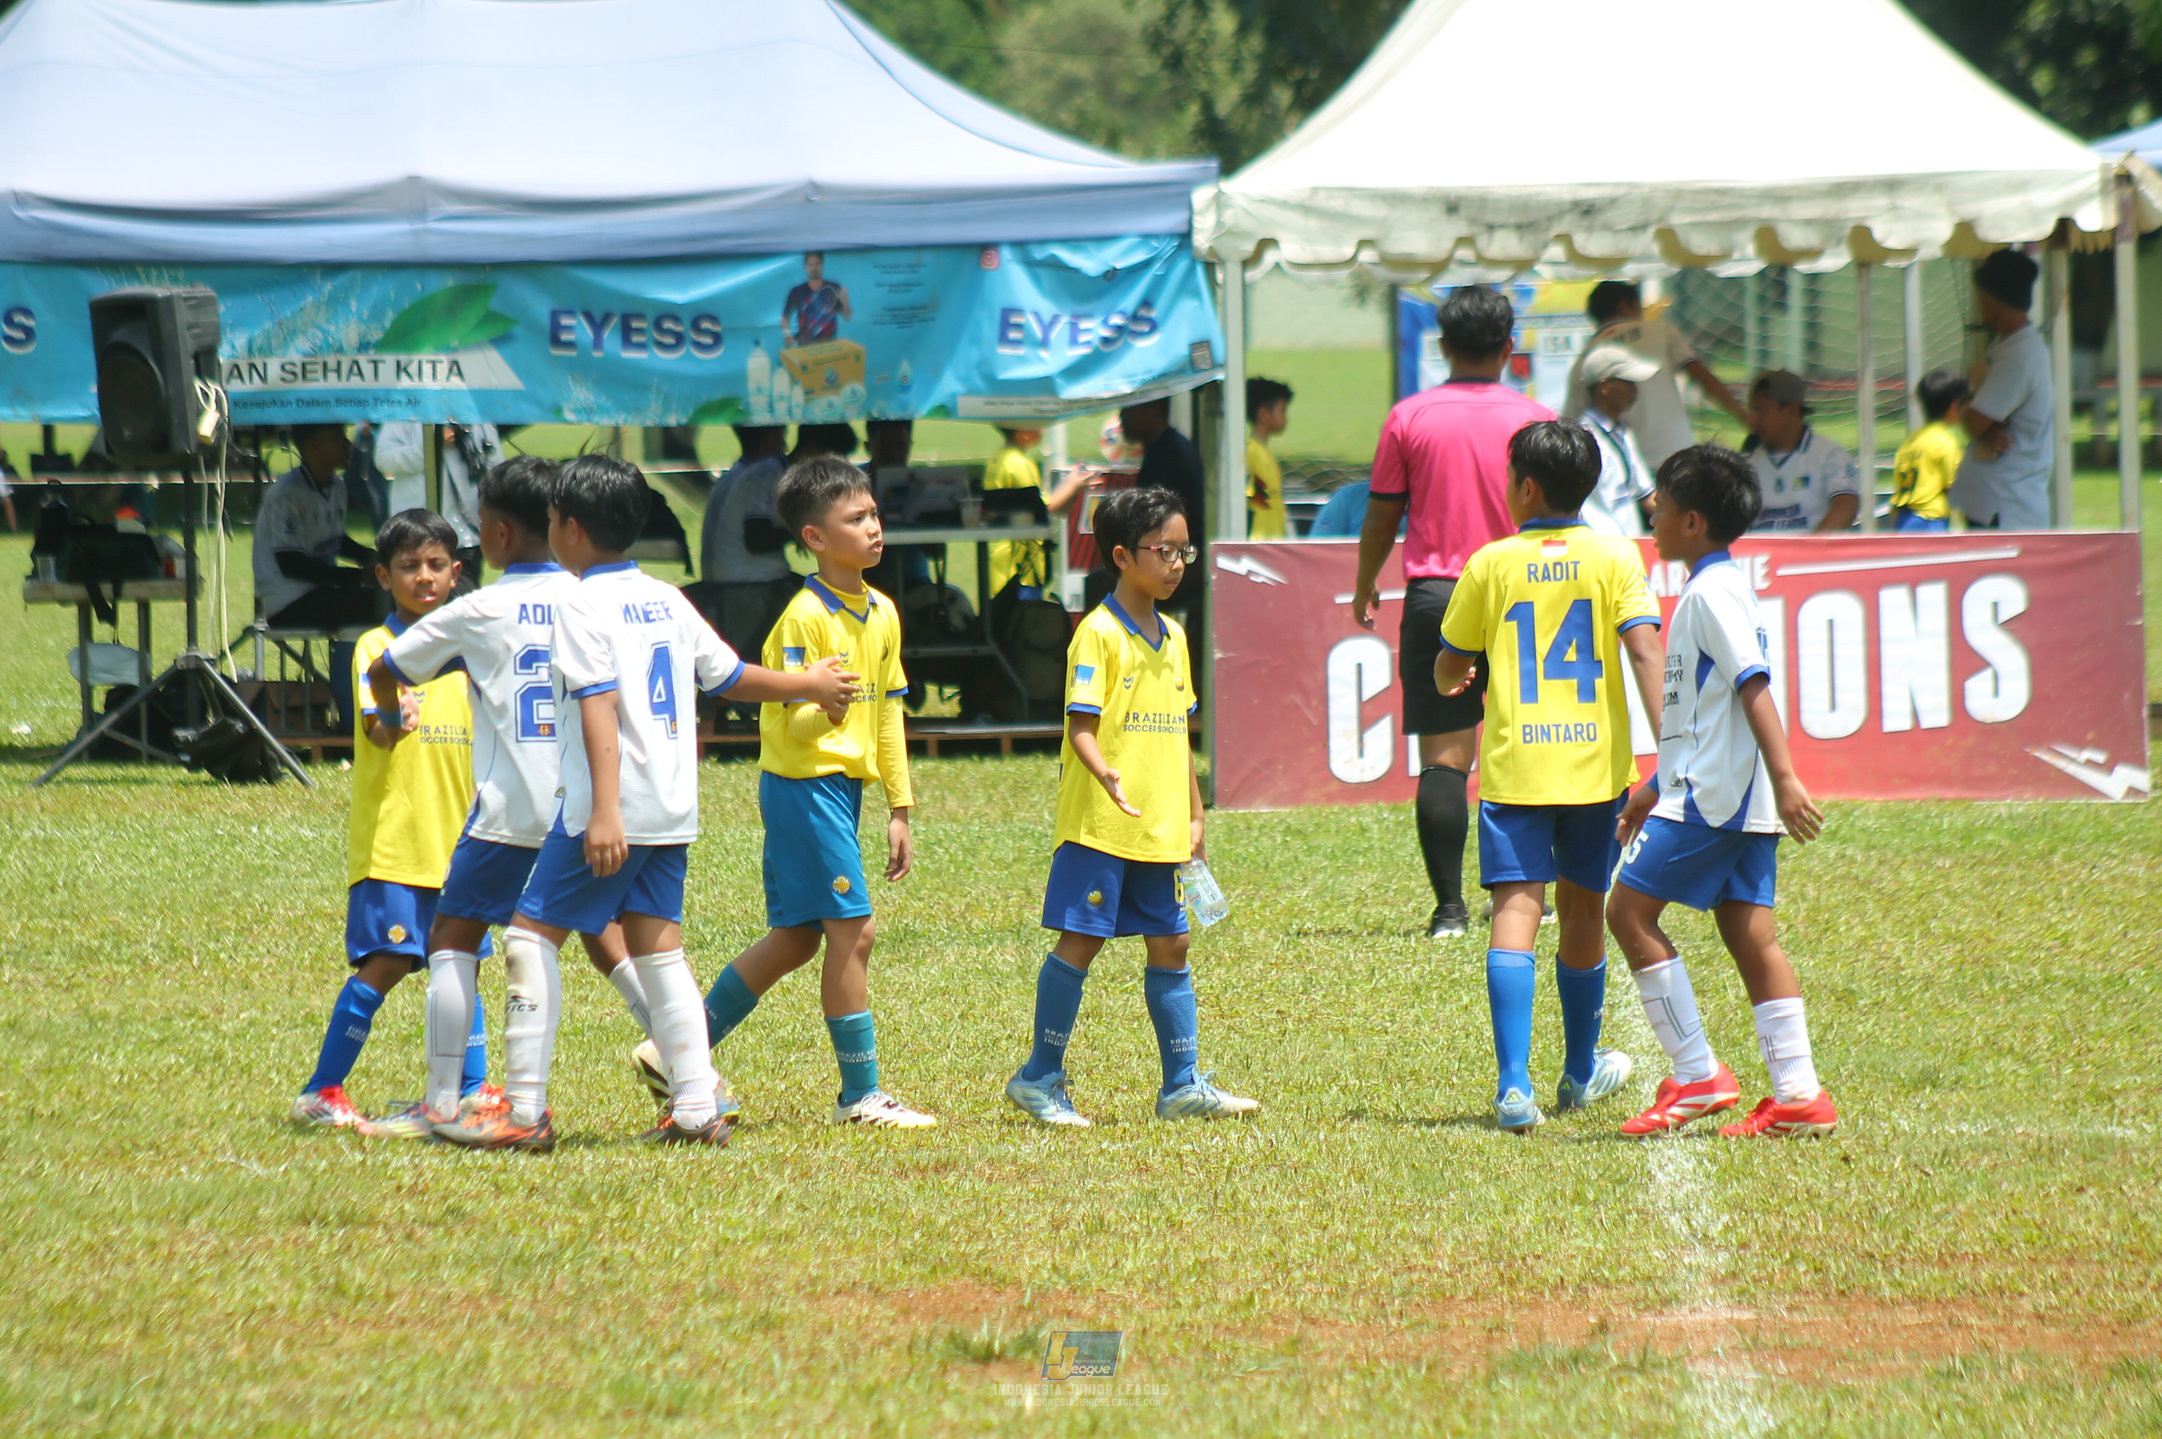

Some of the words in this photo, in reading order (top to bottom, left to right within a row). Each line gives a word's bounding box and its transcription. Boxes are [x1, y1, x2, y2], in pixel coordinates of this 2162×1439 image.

[549, 310, 726, 360] EYESS
[996, 301, 1161, 357] EYESS
[279, 358, 386, 384] SEHAT
[396, 358, 466, 383] KITA
[296, 397, 332, 409] Dalam
[1527, 560, 1581, 583] RADIT
[1504, 598, 1603, 704] 14
[646, 640, 678, 740] 4
[1123, 723, 1157, 733] SOCCER
[1124, 711, 1186, 724] BRAZILIAN
[1522, 723, 1597, 745] BINTARO
